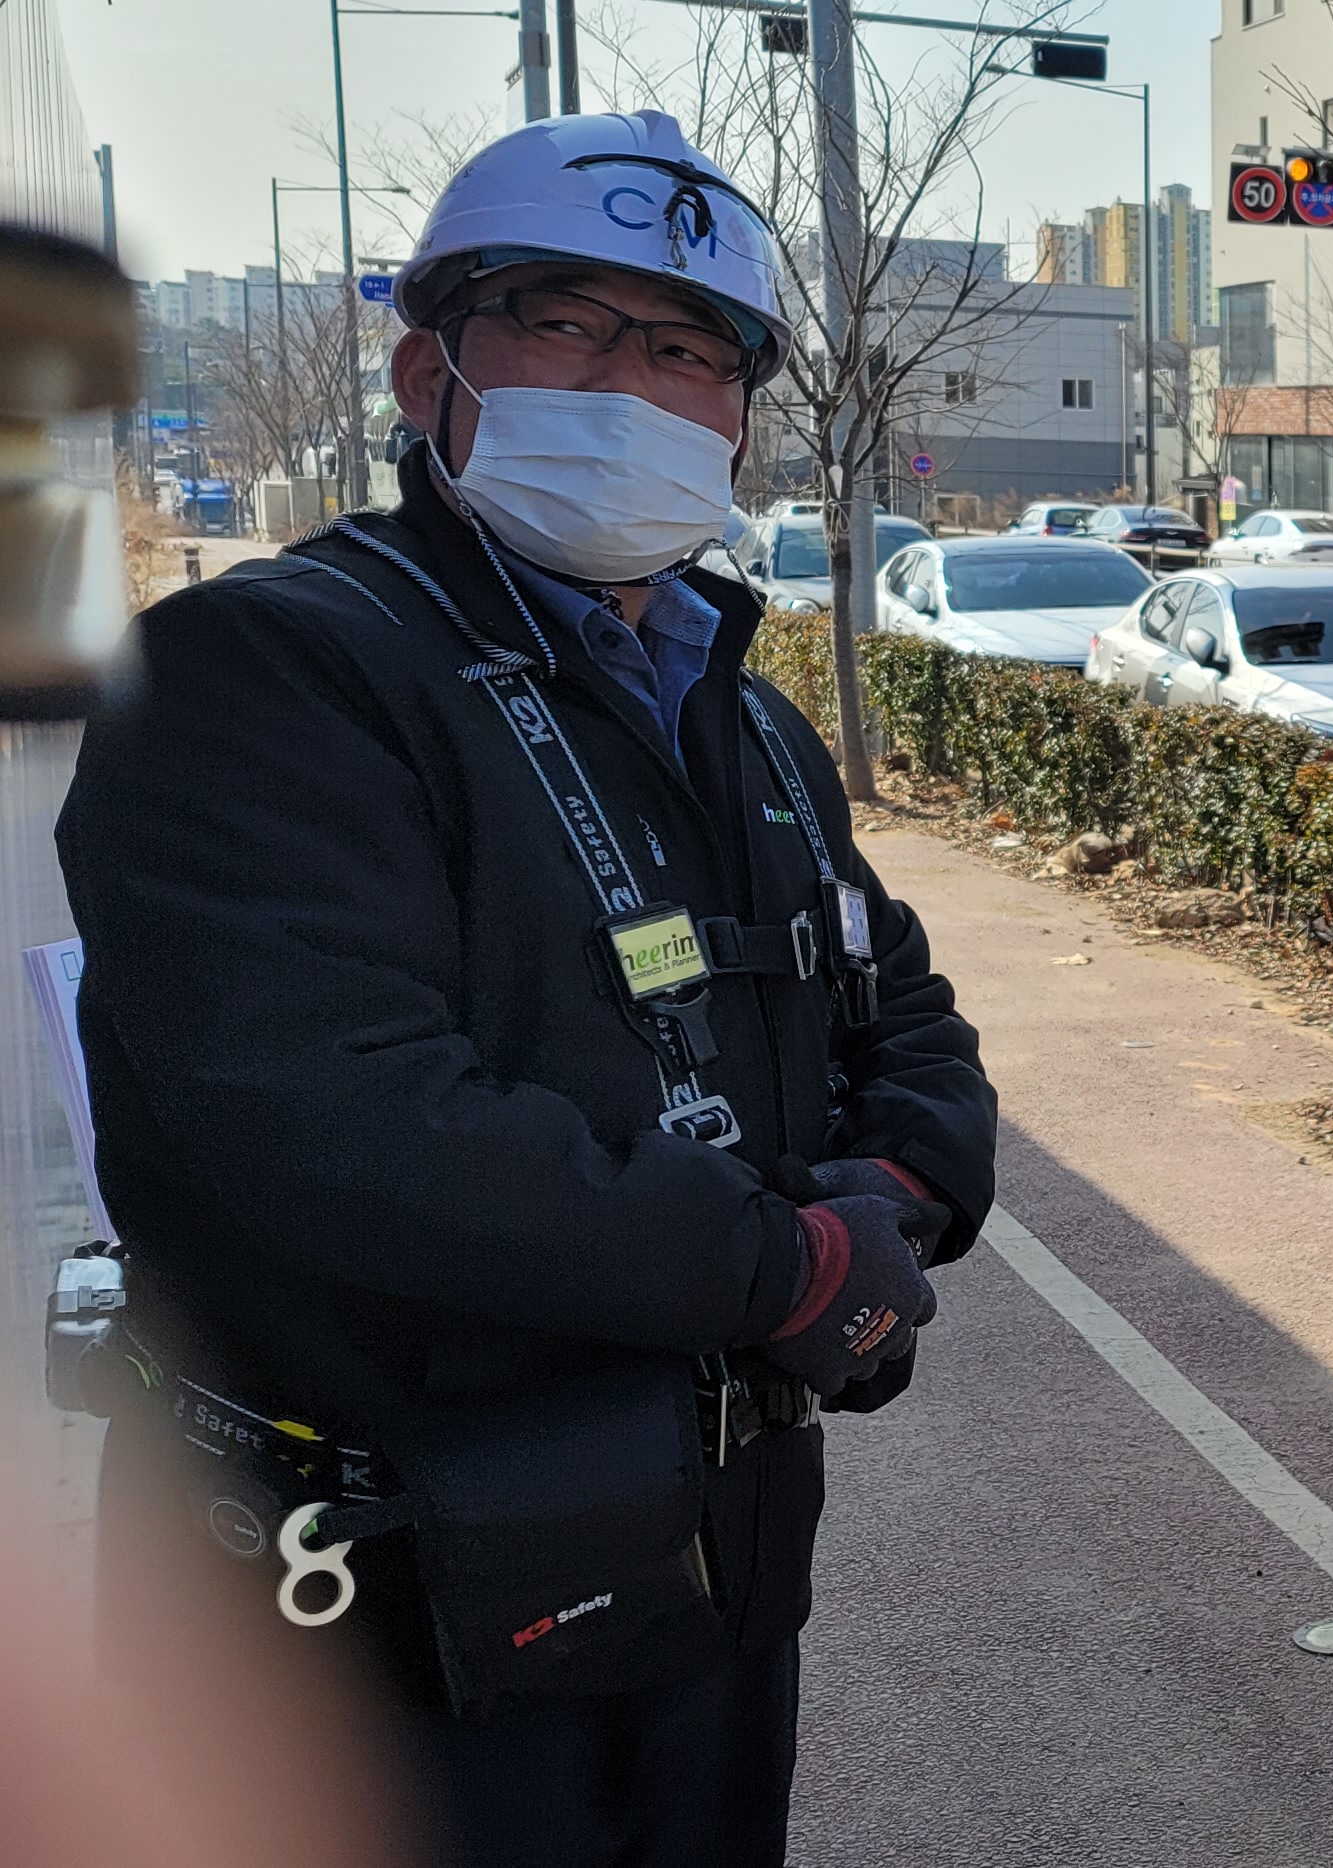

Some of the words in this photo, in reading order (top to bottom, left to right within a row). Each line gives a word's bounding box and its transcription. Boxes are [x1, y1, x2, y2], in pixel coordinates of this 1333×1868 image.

[1243, 181, 1276, 208] 50
[508, 695, 554, 744] K2
[565, 796, 616, 878] Safety
[762, 802, 796, 825] heer
[195, 1402, 265, 1450] Safet
[511, 1616, 555, 1648] K2
[556, 1592, 613, 1624] Safety
